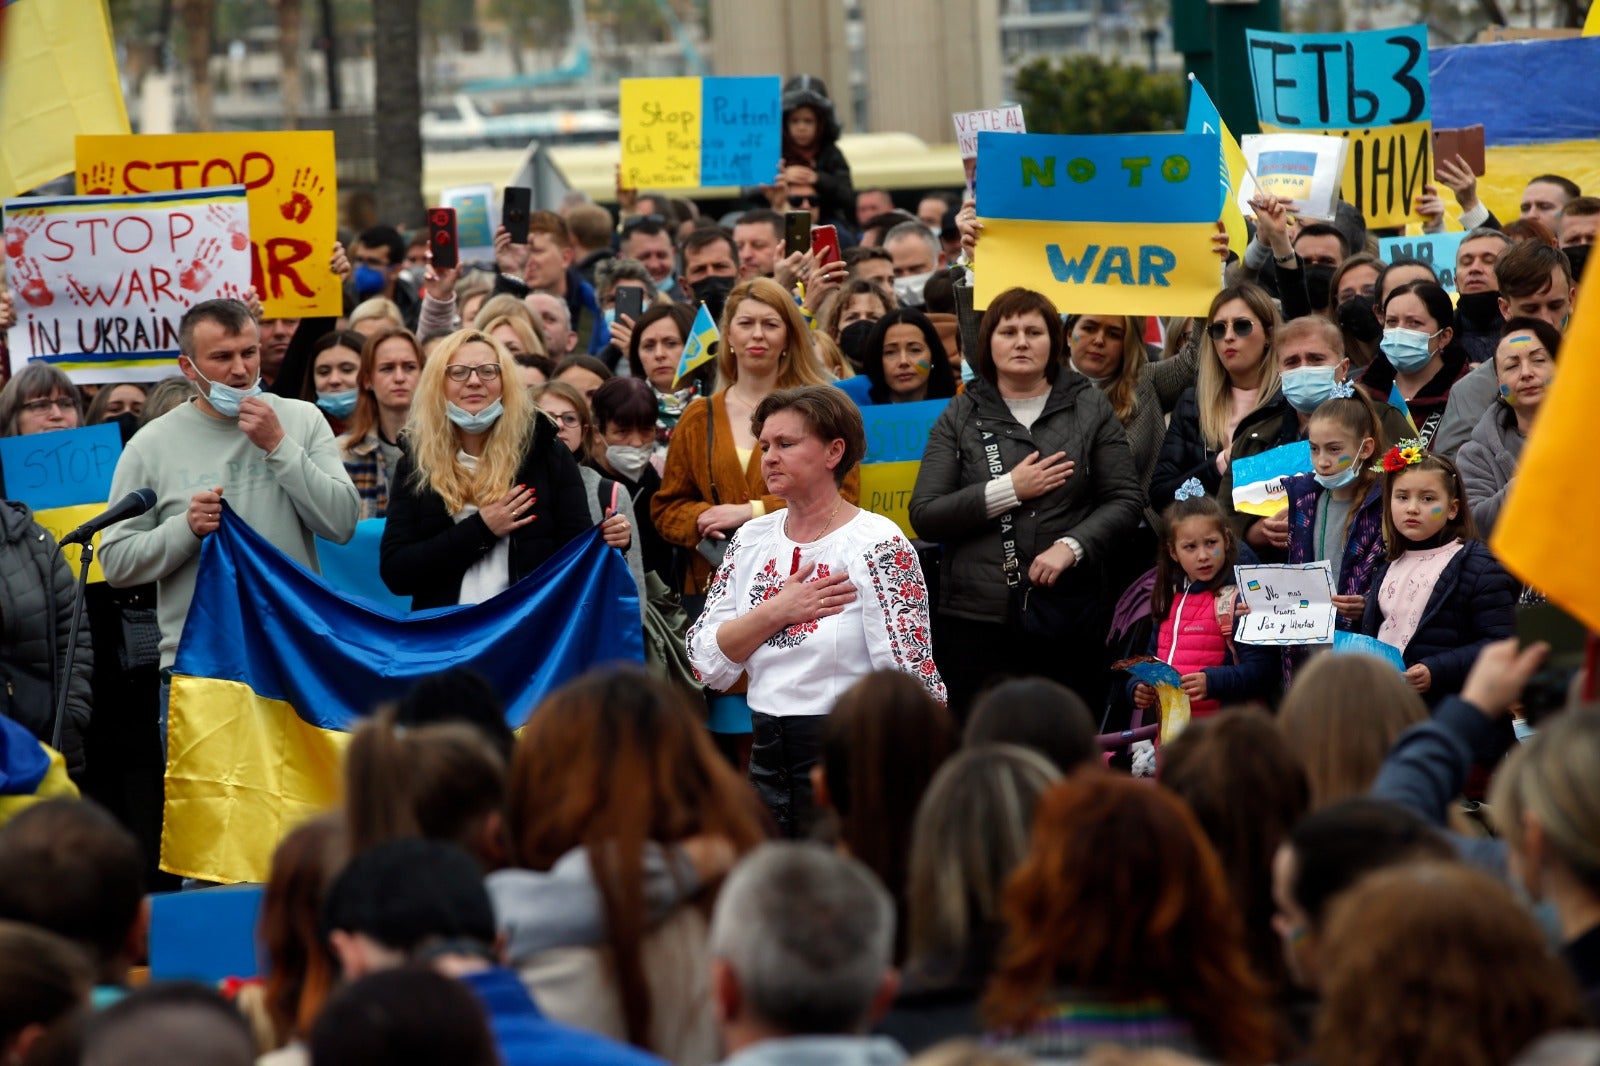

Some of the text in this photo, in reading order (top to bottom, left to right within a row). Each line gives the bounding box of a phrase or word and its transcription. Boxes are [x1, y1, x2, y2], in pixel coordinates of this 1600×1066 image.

[1249, 38, 1380, 125] ГЕТЬ
[639, 95, 777, 133] Stop Putin!
[955, 109, 1022, 132] VETE AL
[122, 151, 275, 196] STOP
[1020, 154, 1191, 188] NO TO
[1282, 178, 1305, 186] WAR
[42, 213, 194, 262] STOP
[1390, 242, 1434, 265] NO
[1045, 243, 1177, 288] WAR
[68, 264, 178, 307] WAR
[24, 440, 113, 488] STOP
[871, 490, 912, 513] PUT
[1265, 585, 1279, 601] No
[1257, 616, 1275, 631] Paz
[1279, 624, 1286, 634] y
